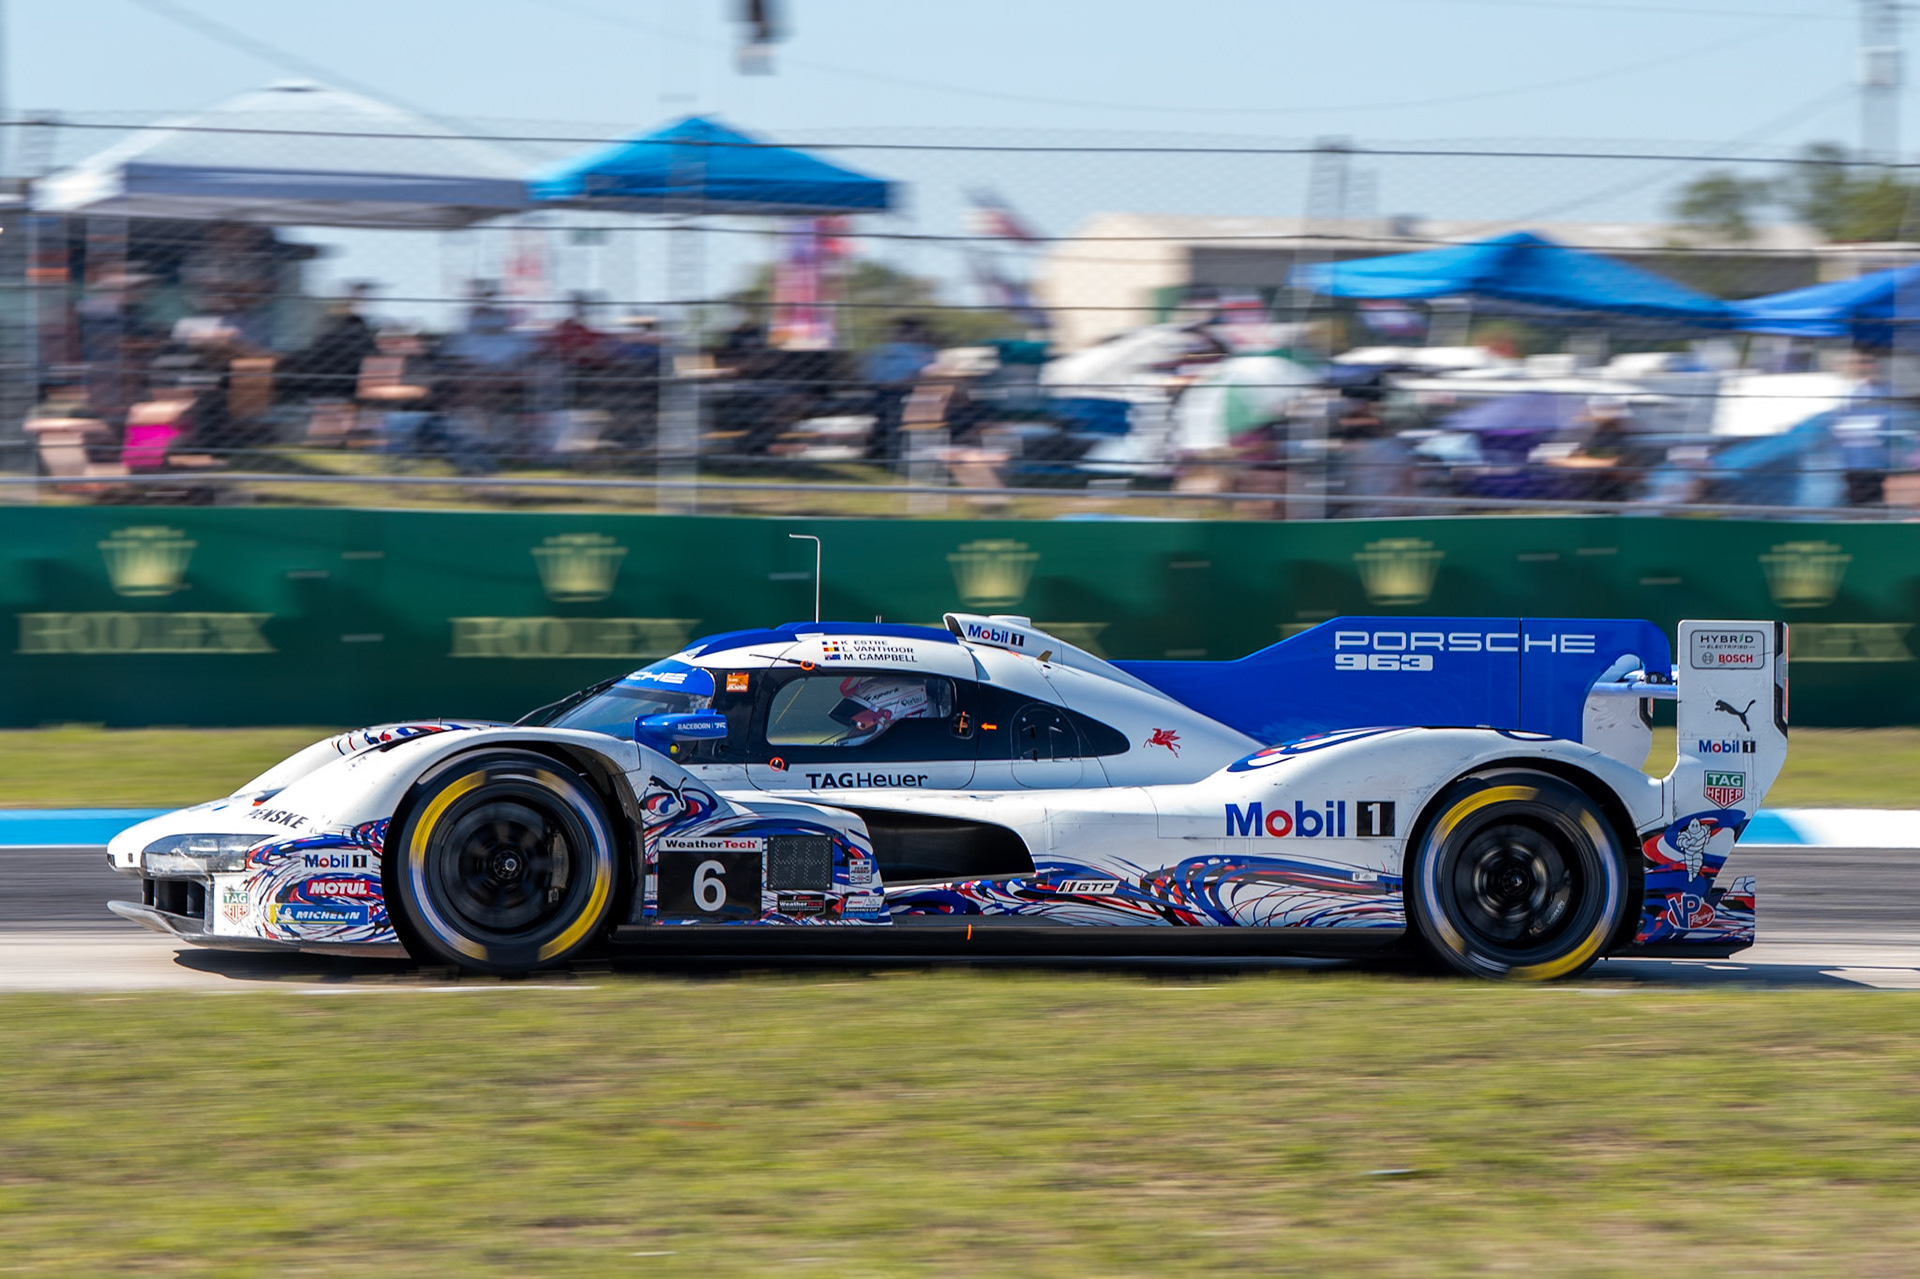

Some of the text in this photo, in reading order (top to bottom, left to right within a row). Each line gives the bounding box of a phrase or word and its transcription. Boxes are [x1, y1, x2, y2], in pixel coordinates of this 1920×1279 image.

[968, 624, 1009, 643] Mobil
[1335, 631, 1596, 653] PORSCHE
[859, 653, 918, 663] CAMPBELL
[1334, 654, 1433, 671] 963
[1718, 654, 1753, 663] BOSCH
[1699, 740, 1739, 753] Mobil
[1708, 774, 1741, 786] TAG
[1706, 787, 1743, 806] HEUER
[1225, 800, 1346, 838] Mobil
[305, 854, 349, 868] Mobil
[309, 882, 367, 895] MOTUL
[692, 859, 728, 912] 6
[1076, 882, 1115, 892] GTP
[225, 892, 247, 903] TAG
[295, 911, 361, 920] MICHELIN
[1668, 894, 1702, 929] VP
